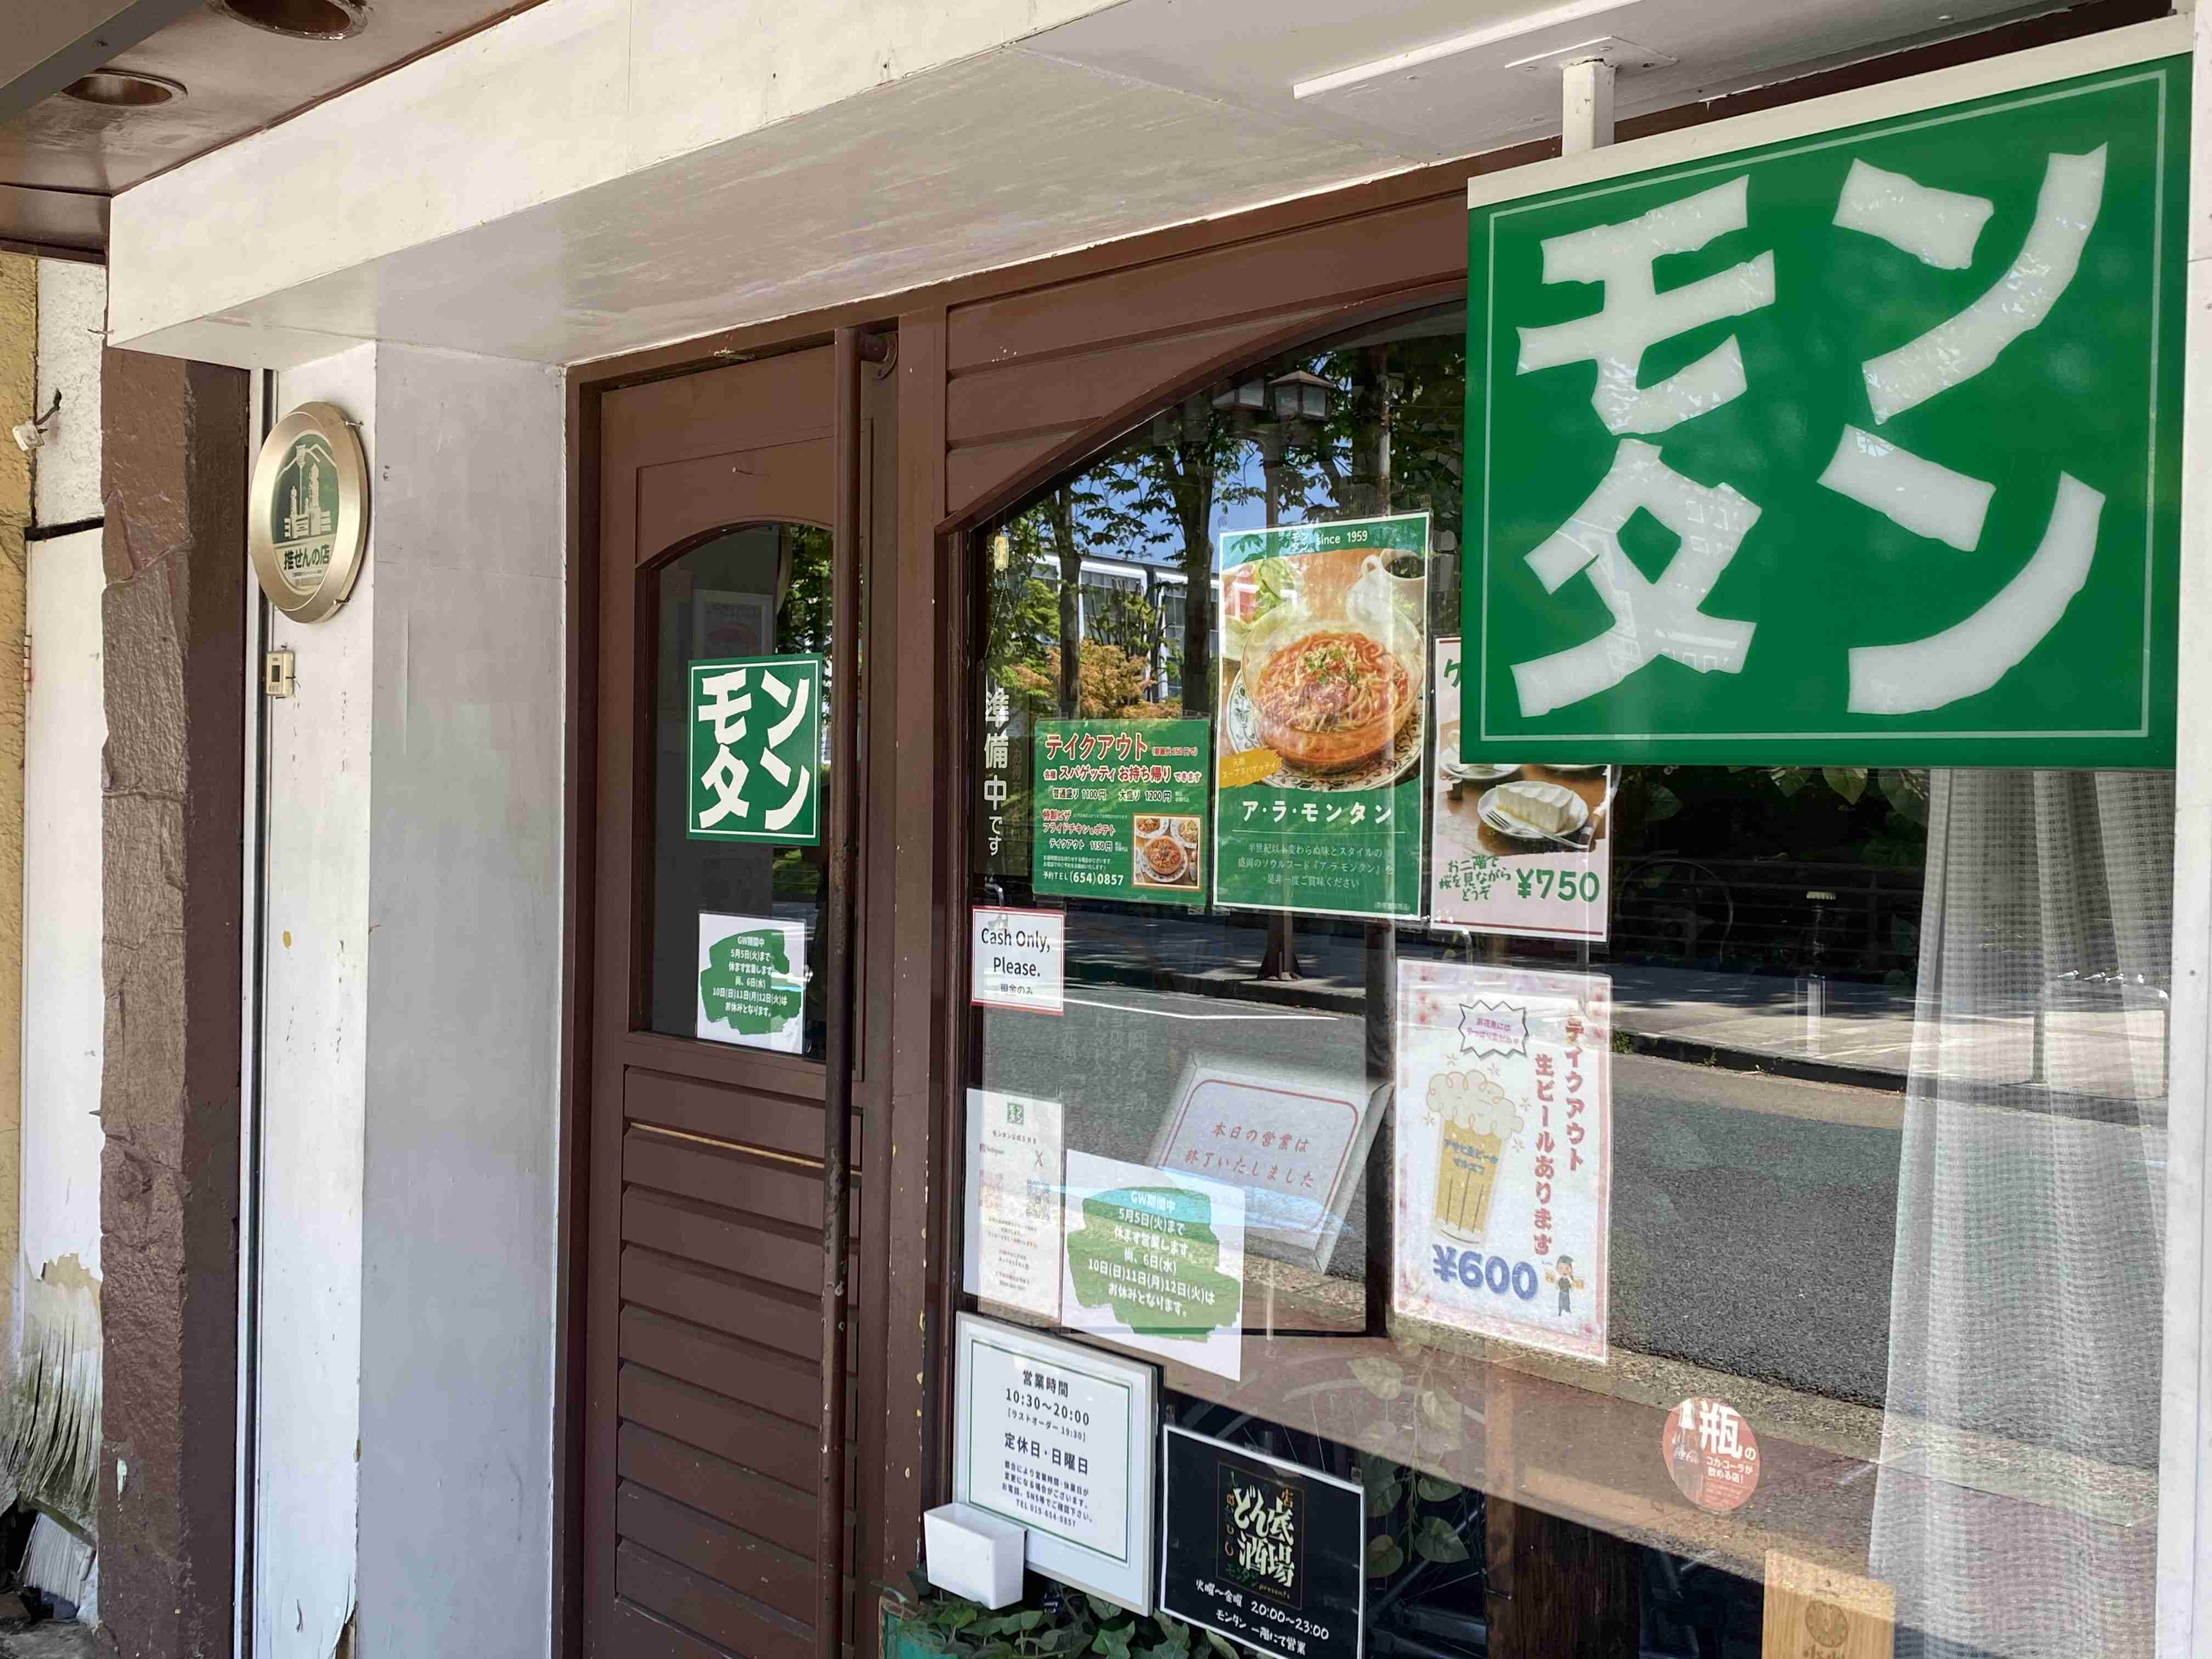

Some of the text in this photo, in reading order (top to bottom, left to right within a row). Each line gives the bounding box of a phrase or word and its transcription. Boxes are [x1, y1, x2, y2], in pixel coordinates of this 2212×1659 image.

[1317, 530, 1368, 545] since 1959
[284, 544, 329, 570] 推せんの店
[1045, 732, 1147, 760] テイクアウト
[984, 687, 1009, 856] 準備中です
[1044, 765, 1201, 783] 各種 スパゲッティ お持ち帰り できます
[1082, 789, 1107, 801] 1100円
[1119, 790, 1140, 801] 大盛り
[1145, 791, 1171, 802] 1200円
[1243, 800, 1392, 825] ア・ラ・モンタン
[1049, 838, 1085, 850] テイクアウト
[1090, 840, 1113, 851] 1150円
[1448, 855, 1499, 872] お二階で
[1439, 867, 1511, 889] 桜を見ながら
[1516, 868, 1600, 902] ¥750
[1462, 885, 1492, 901] どうぞ
[981, 928, 1050, 952] Cash Only,
[731, 949, 771, 961] 5月5日(火)まで
[994, 957, 1040, 977] Please.
[713, 988, 787, 1006] 10日(日)11日(月)12日(火)は
[1001, 984, 1033, 995] 現金のみ
[725, 1003, 771, 1017] お休みとなります。
[1565, 1018, 1584, 1171] テイクアウト
[1211, 1122, 1309, 1153] 本日の営業は
[1533, 1053, 1555, 1256] 生ビールあります
[1185, 1149, 1316, 1188] 終了いたしました
[1131, 1191, 1176, 1213] GW期間中
[1119, 1208, 1185, 1236] 5月5日(火)まで
[1088, 1259, 1215, 1305] 10日(日)11日(月)12日(火)は
[1432, 1243, 1538, 1301] ¥600
[1108, 1282, 1186, 1317] お休みとなります。
[1023, 1369, 1068, 1397] 営業時間
[1005, 1432, 1087, 1475] 定休日・日曜日
[1216, 1609, 1306, 1655] モンタン 一階にて営業
